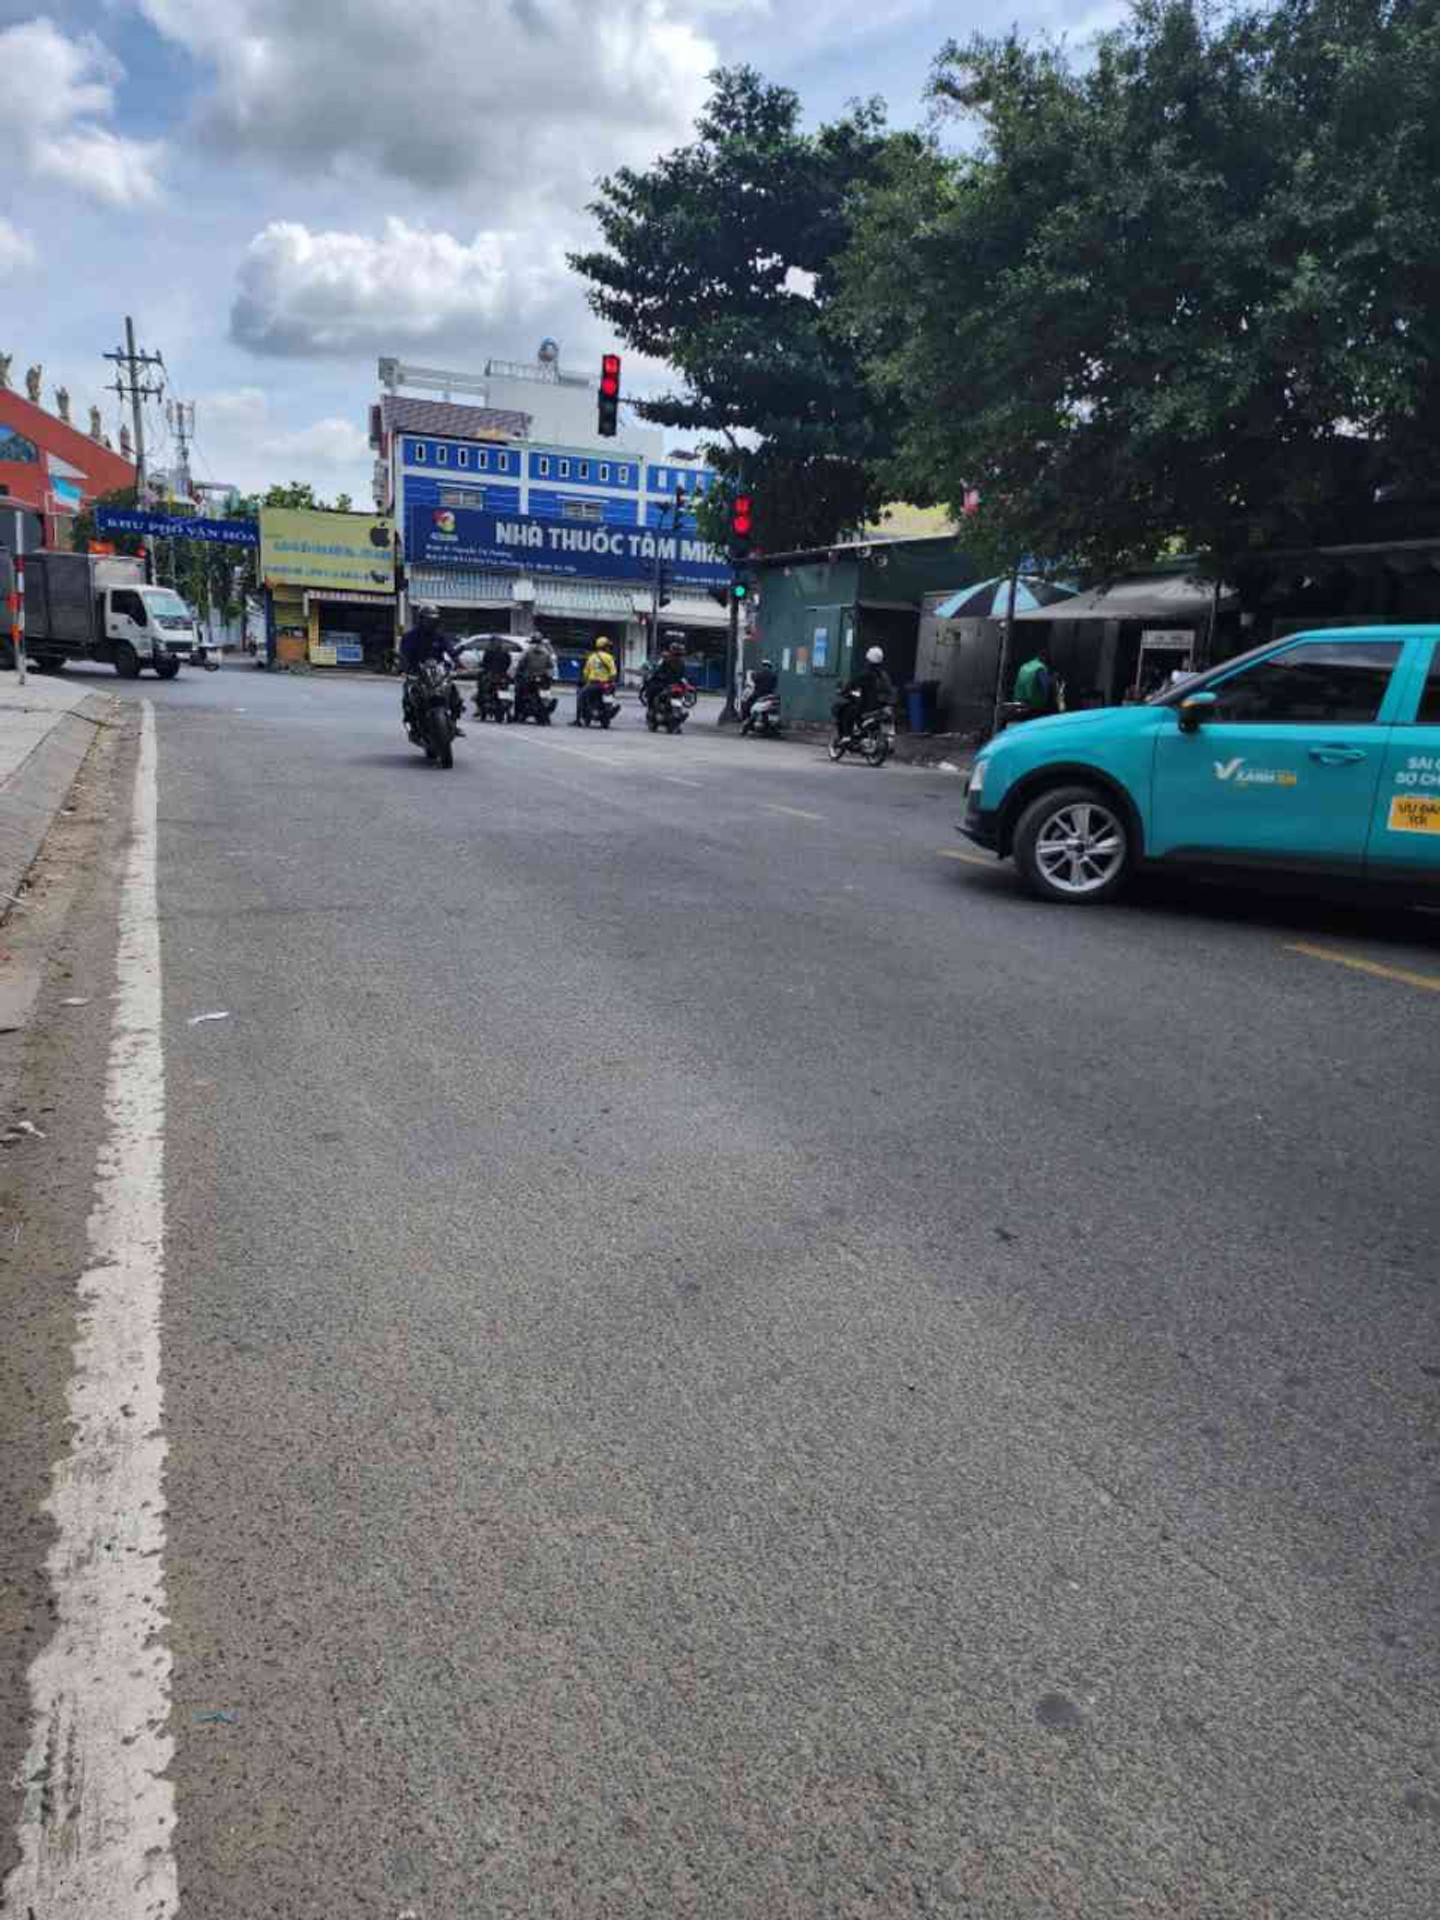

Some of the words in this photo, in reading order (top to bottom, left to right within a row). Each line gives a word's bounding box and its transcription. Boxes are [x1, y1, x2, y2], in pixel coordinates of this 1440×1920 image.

[495, 520, 543, 548] NHÀ
[548, 525, 625, 555] THUỐC
[628, 531, 676, 561] TÂM
